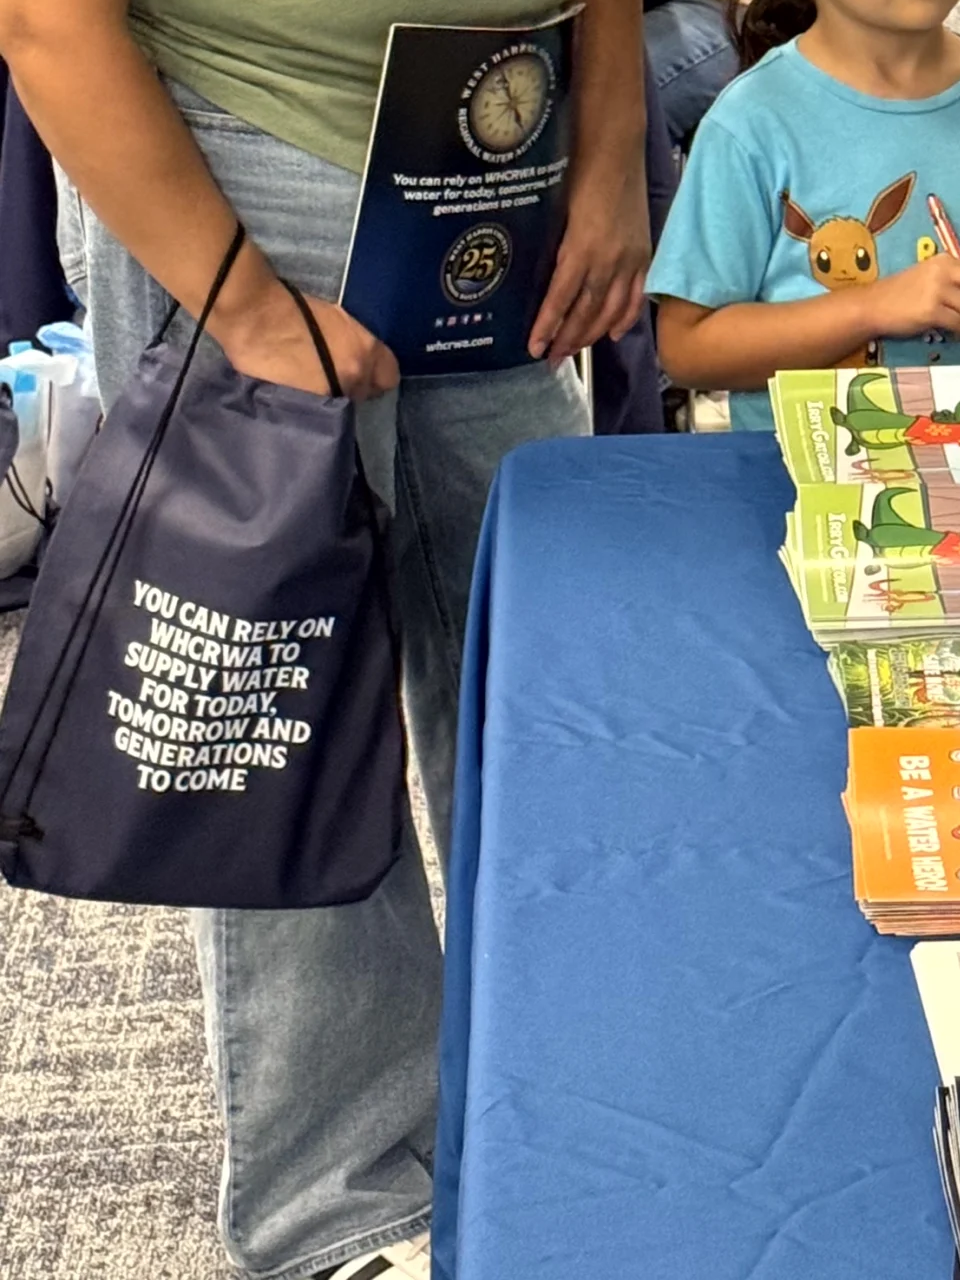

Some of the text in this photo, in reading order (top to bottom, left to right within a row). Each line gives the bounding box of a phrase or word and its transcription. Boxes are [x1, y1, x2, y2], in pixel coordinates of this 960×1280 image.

[461, 62, 488, 99] WEST
[482, 152, 514, 163] WATER
[392, 173, 417, 186] You
[419, 176, 441, 187] can
[443, 174, 467, 188] rely
[468, 175, 482, 185] on
[403, 190, 441, 201] water
[444, 188, 460, 200] for
[463, 187, 496, 199] today,
[432, 200, 499, 216] generations
[501, 200, 512, 208] to
[459, 246, 497, 279] 25
[426, 337, 493, 352] whcrwa.com
[134, 579, 335, 643] YOU CAN RELY ON
[150, 618, 301, 668] WHCRWA TO
[124, 641, 310, 693] SUPPLY WATER
[140, 677, 278, 718] FOR TODAY,
[107, 691, 312, 744] TOMORROW AND
[115, 726, 288, 769] GENERATIONS
[136, 765, 248, 793] TO COME
[899, 755, 948, 892] BE A WATER HERO!
